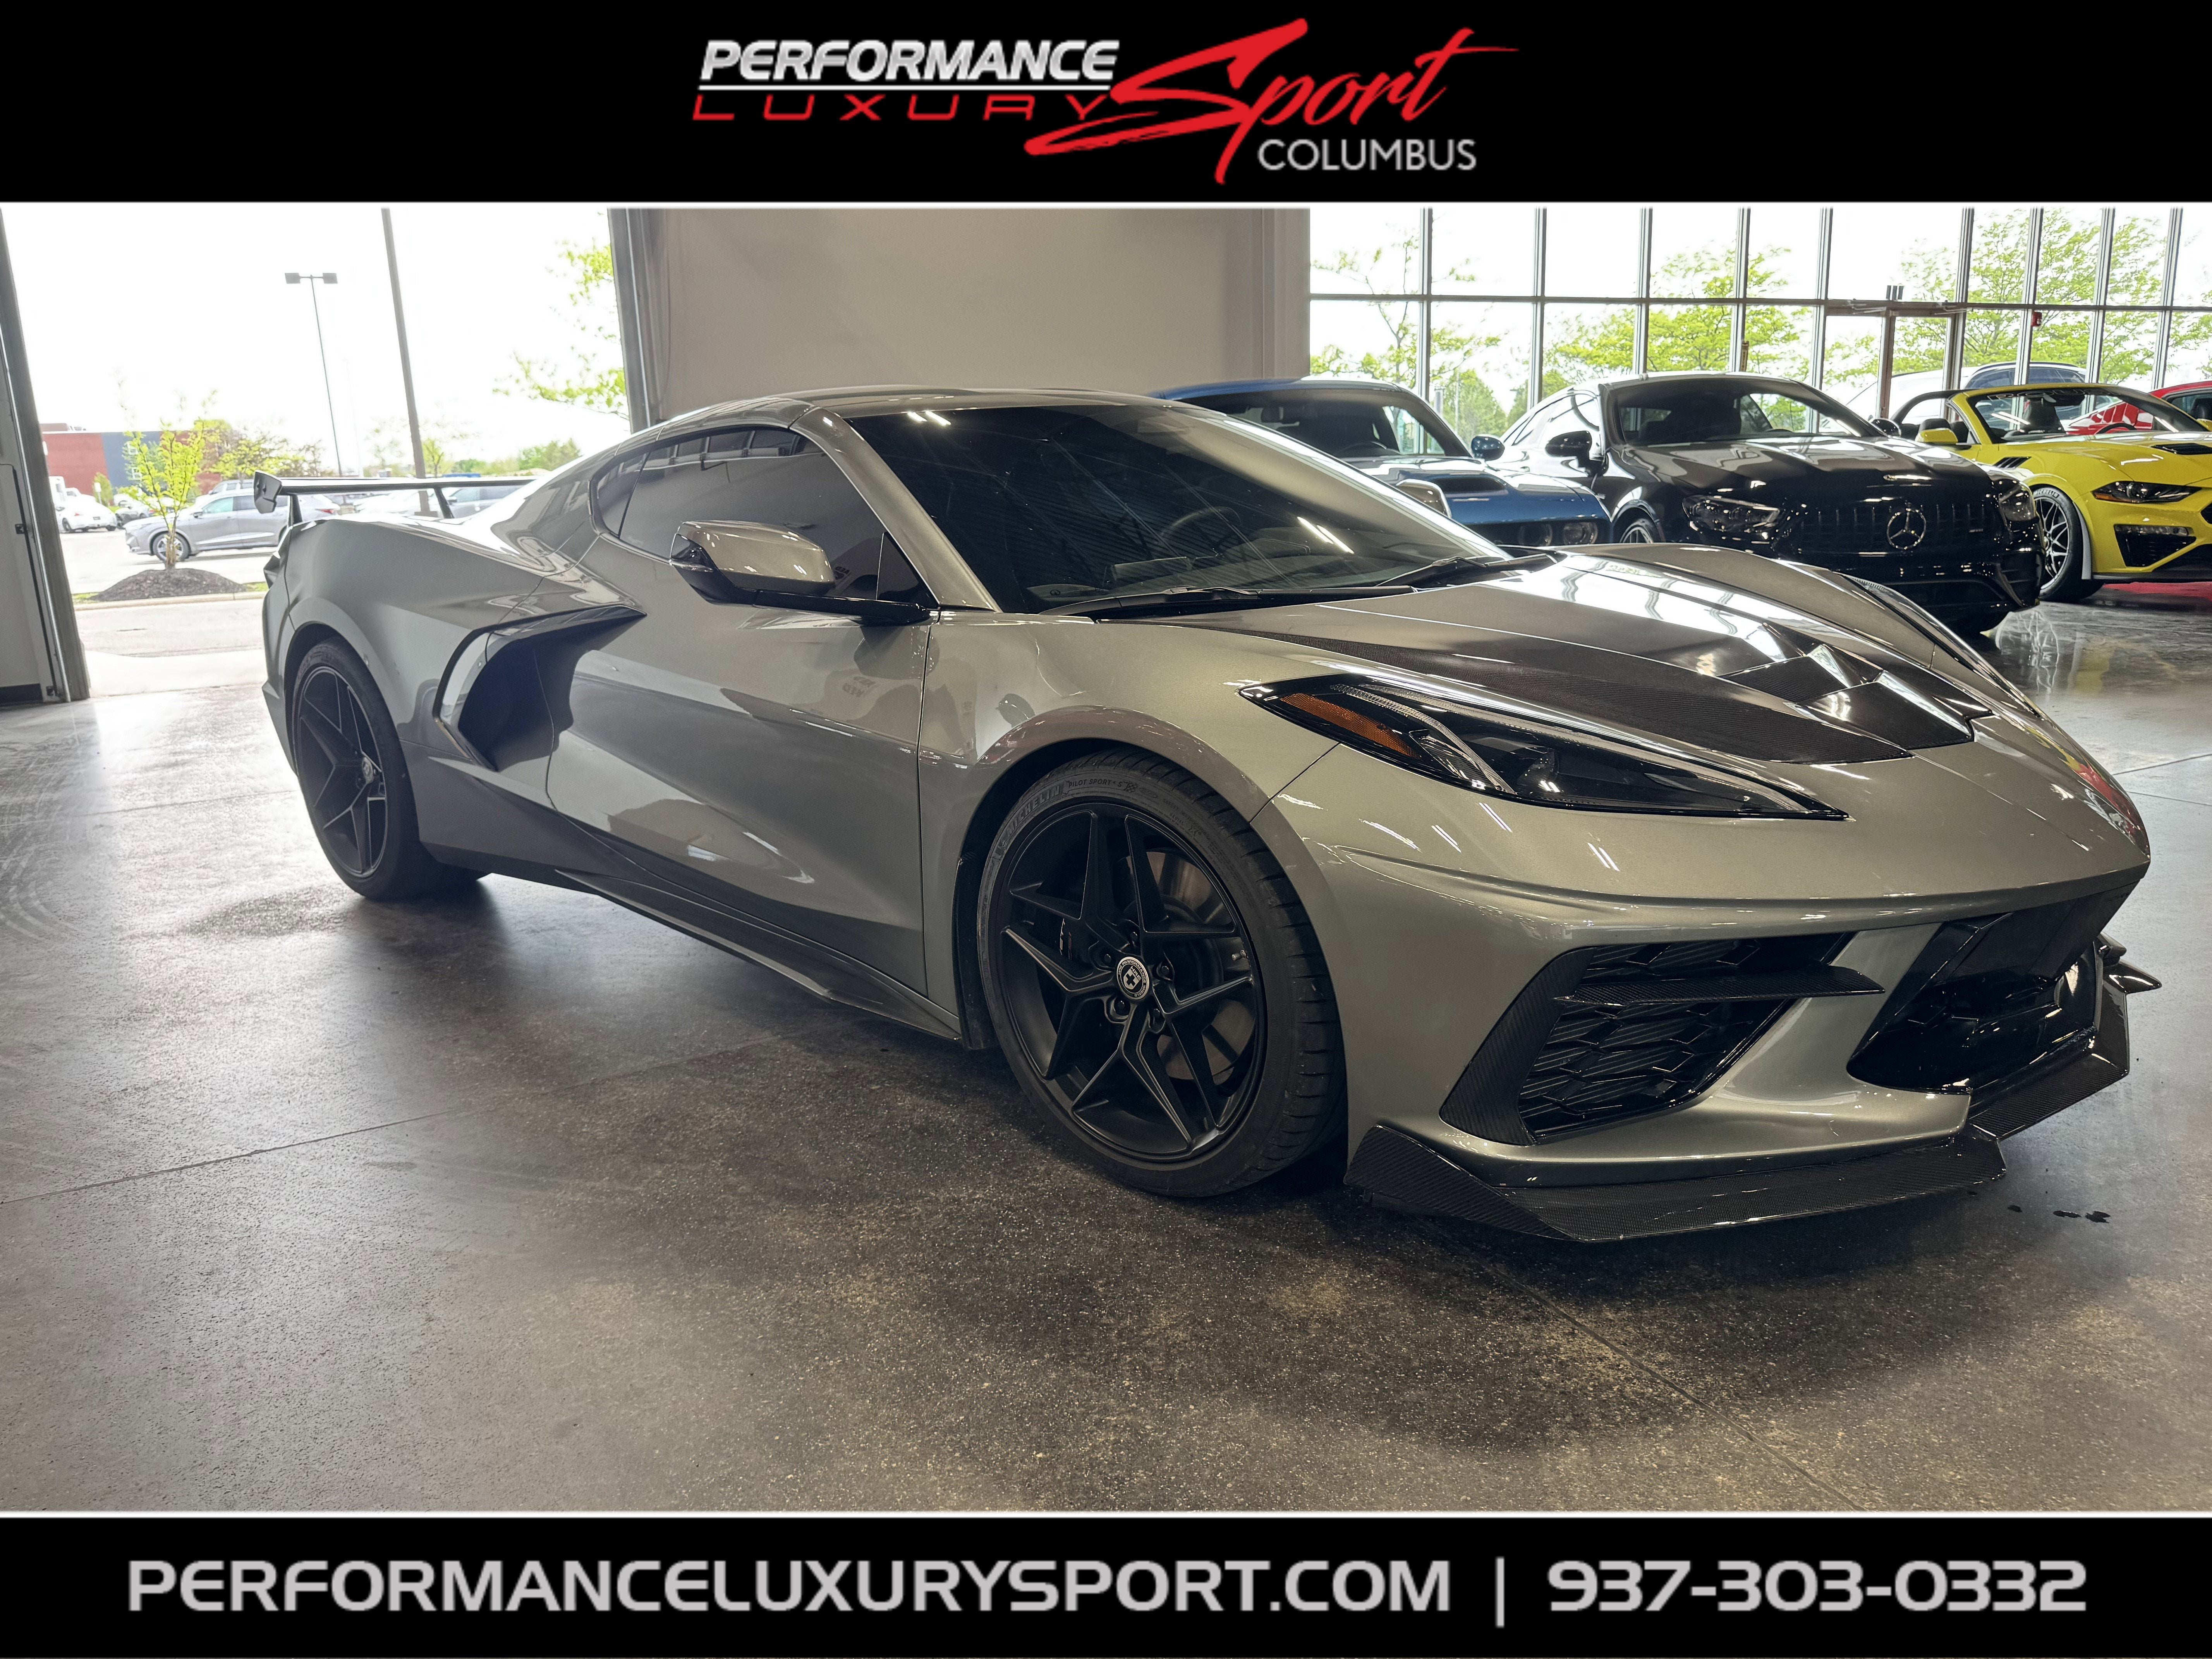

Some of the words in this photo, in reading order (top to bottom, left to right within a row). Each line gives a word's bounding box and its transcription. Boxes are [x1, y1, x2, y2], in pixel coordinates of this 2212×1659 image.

[1069, 779, 1087, 788] PILOT
[1006, 785, 1061, 837] MICHELIN
[1130, 965, 1142, 981] HRE
